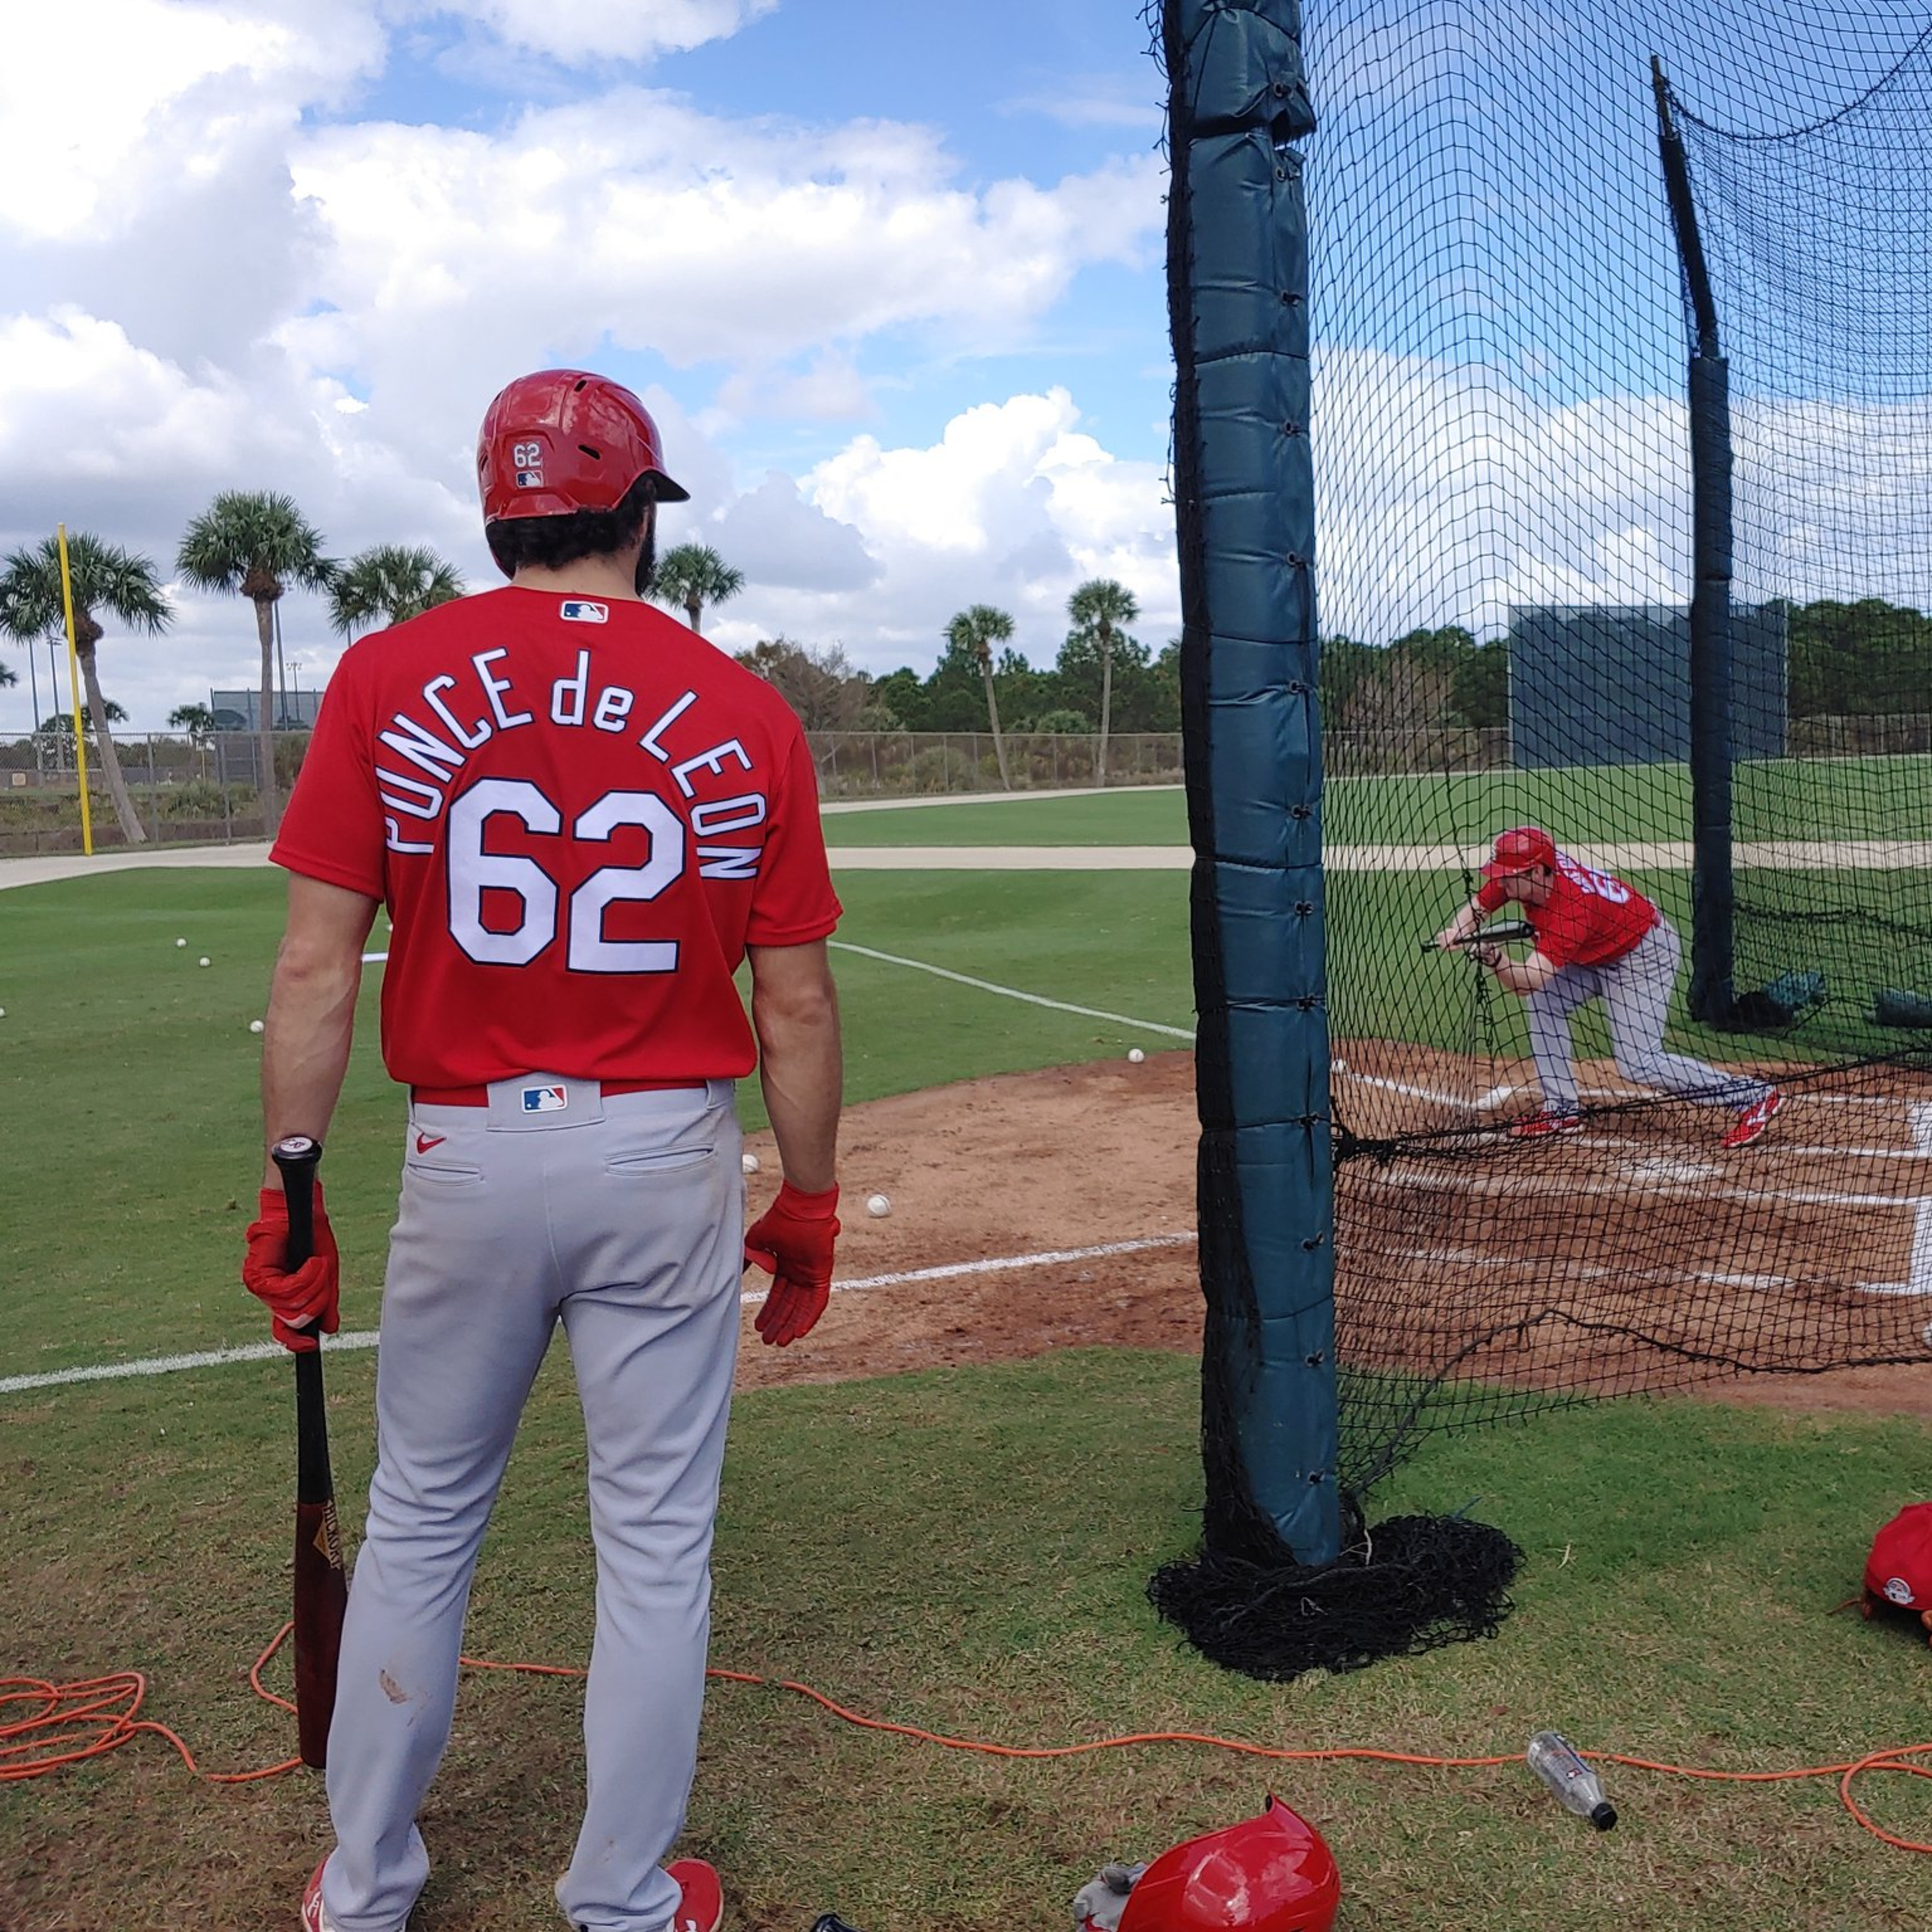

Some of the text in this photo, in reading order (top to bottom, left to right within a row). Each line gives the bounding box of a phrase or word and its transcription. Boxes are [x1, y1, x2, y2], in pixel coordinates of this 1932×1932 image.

[514, 442, 542, 468] 62
[375, 646, 766, 880] PONCE de LEON
[446, 777, 686, 975] 62
